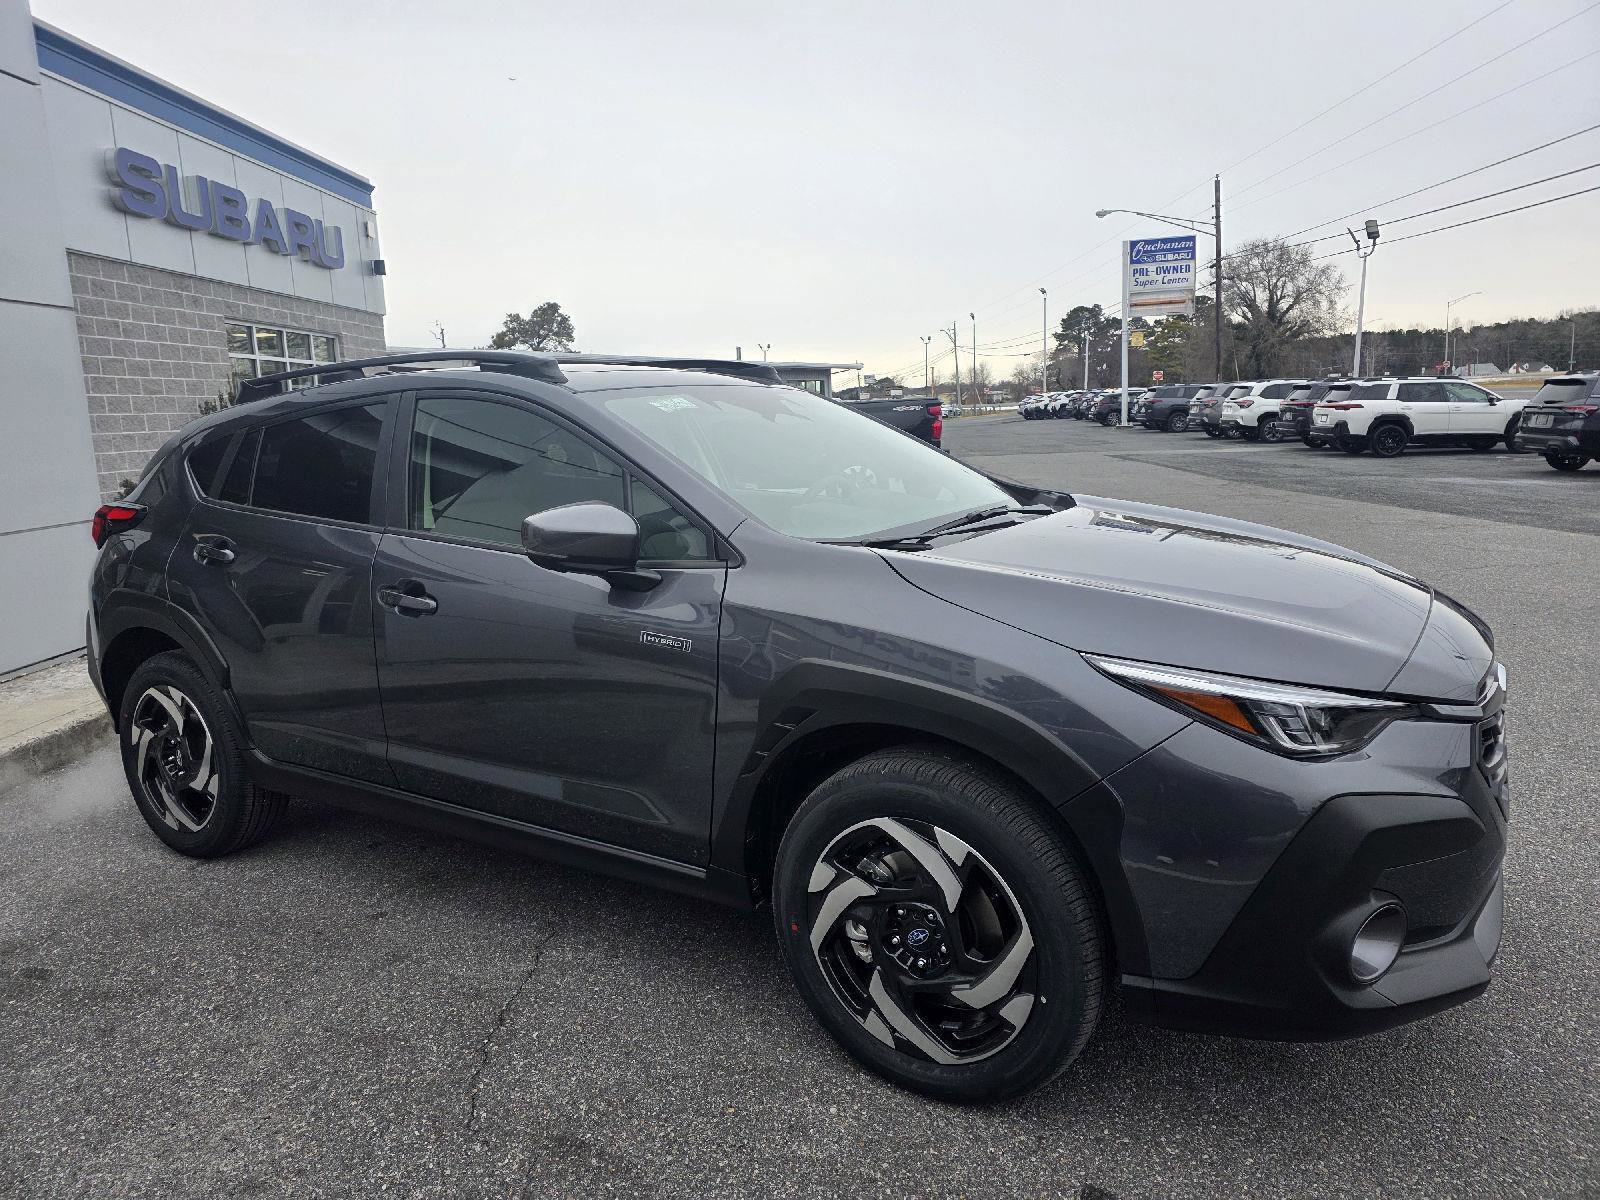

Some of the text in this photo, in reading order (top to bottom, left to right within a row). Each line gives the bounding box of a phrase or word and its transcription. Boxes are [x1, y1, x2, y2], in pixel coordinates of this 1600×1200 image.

[113, 147, 344, 269] SUBARU
[1132, 241, 1193, 260] Buchanan
[1155, 252, 1191, 261] SUBARU
[1132, 264, 1191, 277] PRE-OWNED
[1133, 275, 1189, 287] Super Center
[647, 635, 682, 647] HYBRID
